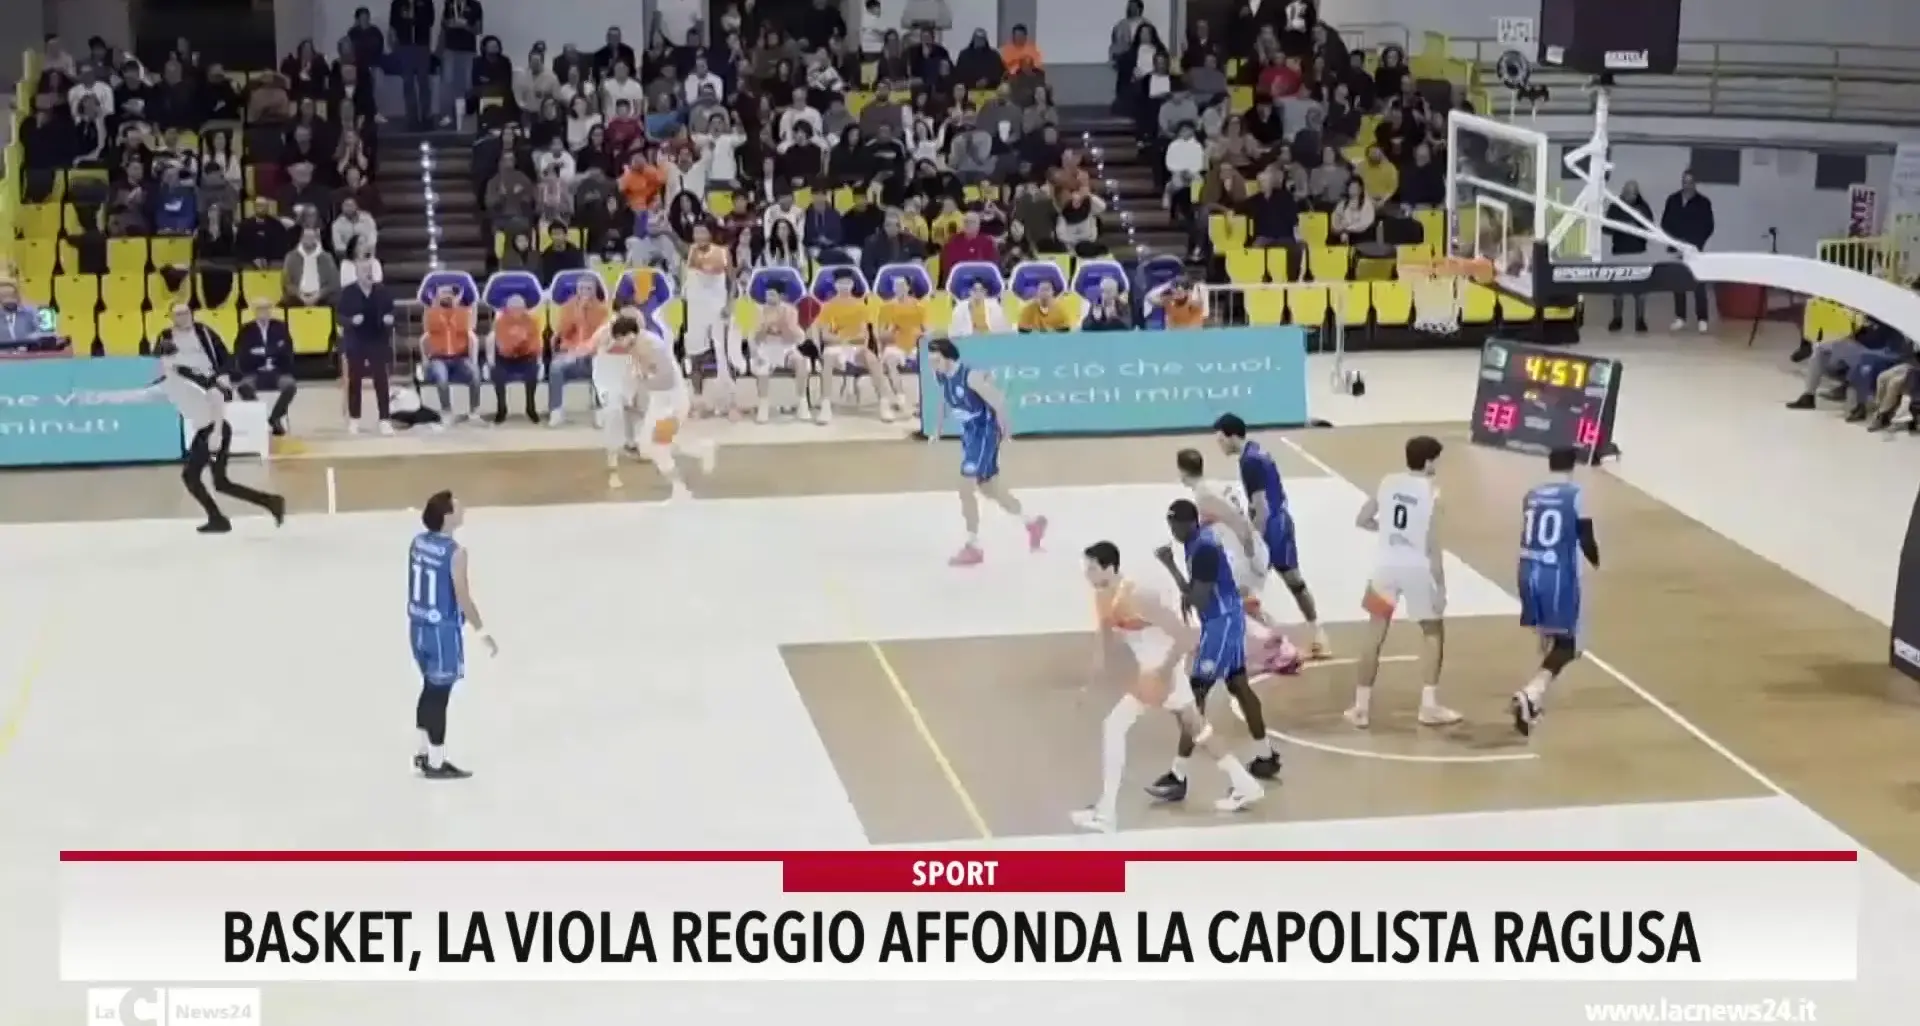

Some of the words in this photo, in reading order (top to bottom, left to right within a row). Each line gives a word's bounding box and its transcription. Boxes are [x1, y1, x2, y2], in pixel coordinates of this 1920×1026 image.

[1119, 358, 1184, 377] che
[1525, 355, 1587, 389] 4:57
[1483, 402, 1518, 431] 33
[1393, 503, 1408, 531] 0
[1525, 508, 1562, 547] 10
[412, 562, 437, 606] 11
